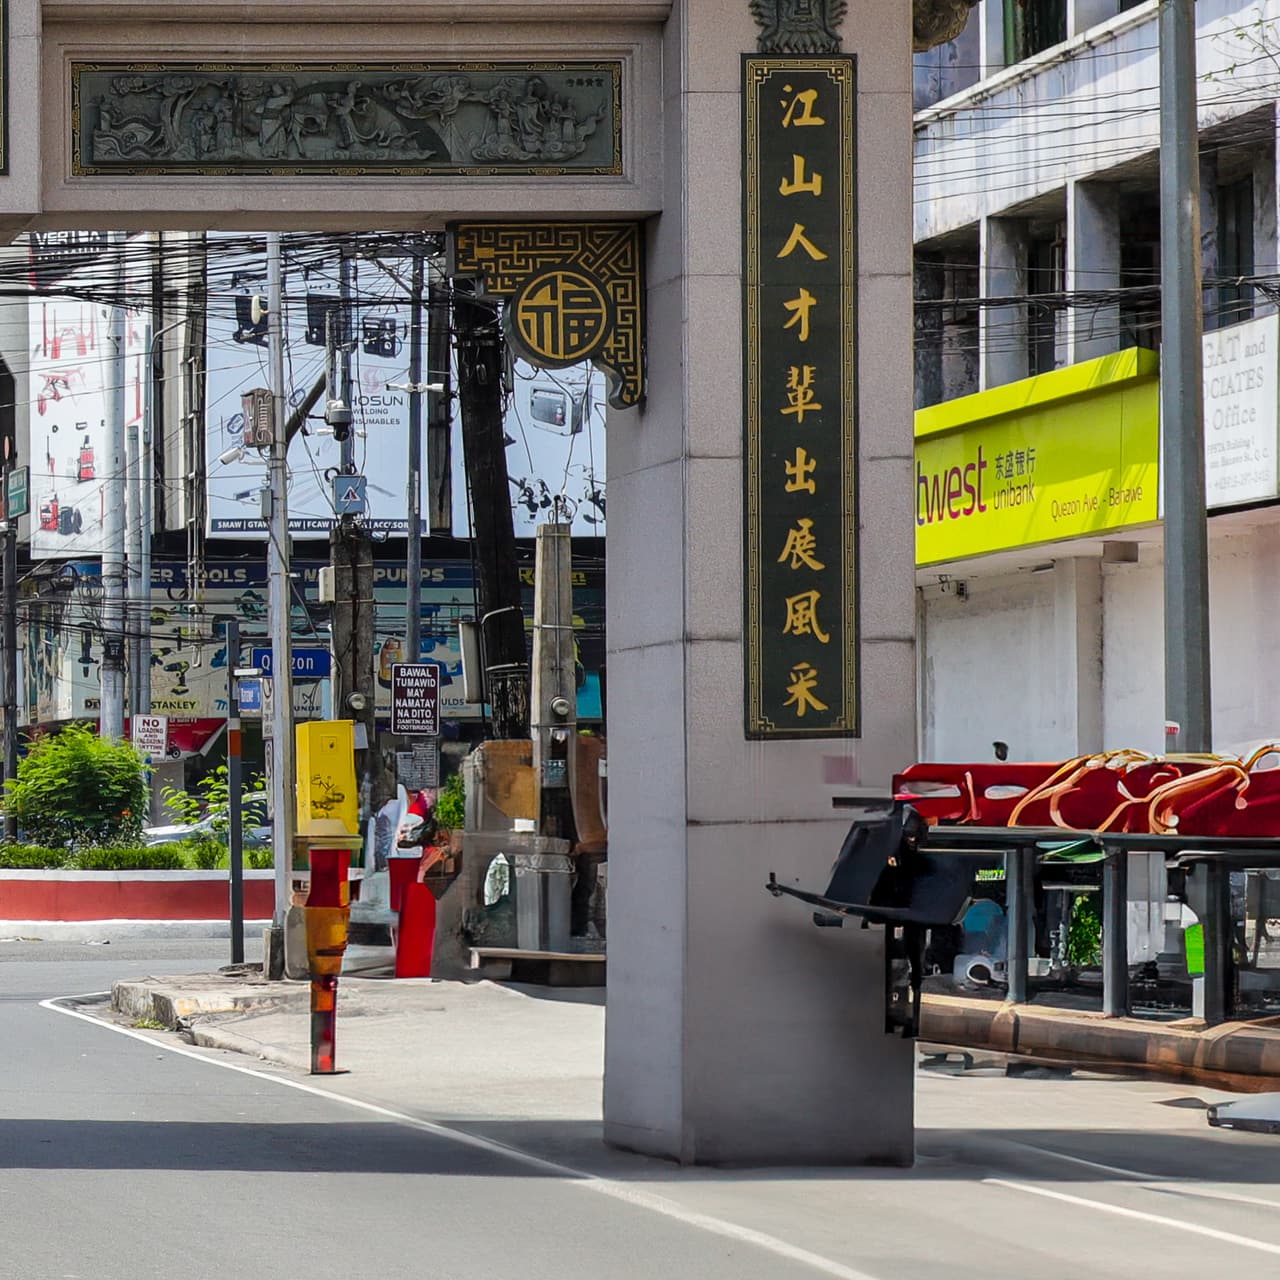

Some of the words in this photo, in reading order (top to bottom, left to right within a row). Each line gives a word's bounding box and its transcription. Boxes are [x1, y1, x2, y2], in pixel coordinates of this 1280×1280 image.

[776, 84, 829, 718] 江山人才輩出展風采
[1212, 405, 1257, 431] Office
[993, 477, 1035, 510] unibank
[1051, 497, 1081, 522] Quezon
[1109, 485, 1143, 507] Banawe
[218, 521, 242, 529] SMAW
[307, 521, 329, 529] FCAW
[261, 655, 314, 671] Qzon
[400, 668, 432, 677] BAWAL
[396, 678, 436, 687] TUMAWID
[406, 689, 425, 697] MAY
[151, 701, 196, 710] STANLEY
[396, 699, 435, 708] NAMATAY
[397, 709, 409, 718] NA
[411, 709, 434, 718] DITO.
[143, 719, 160, 727] NO
